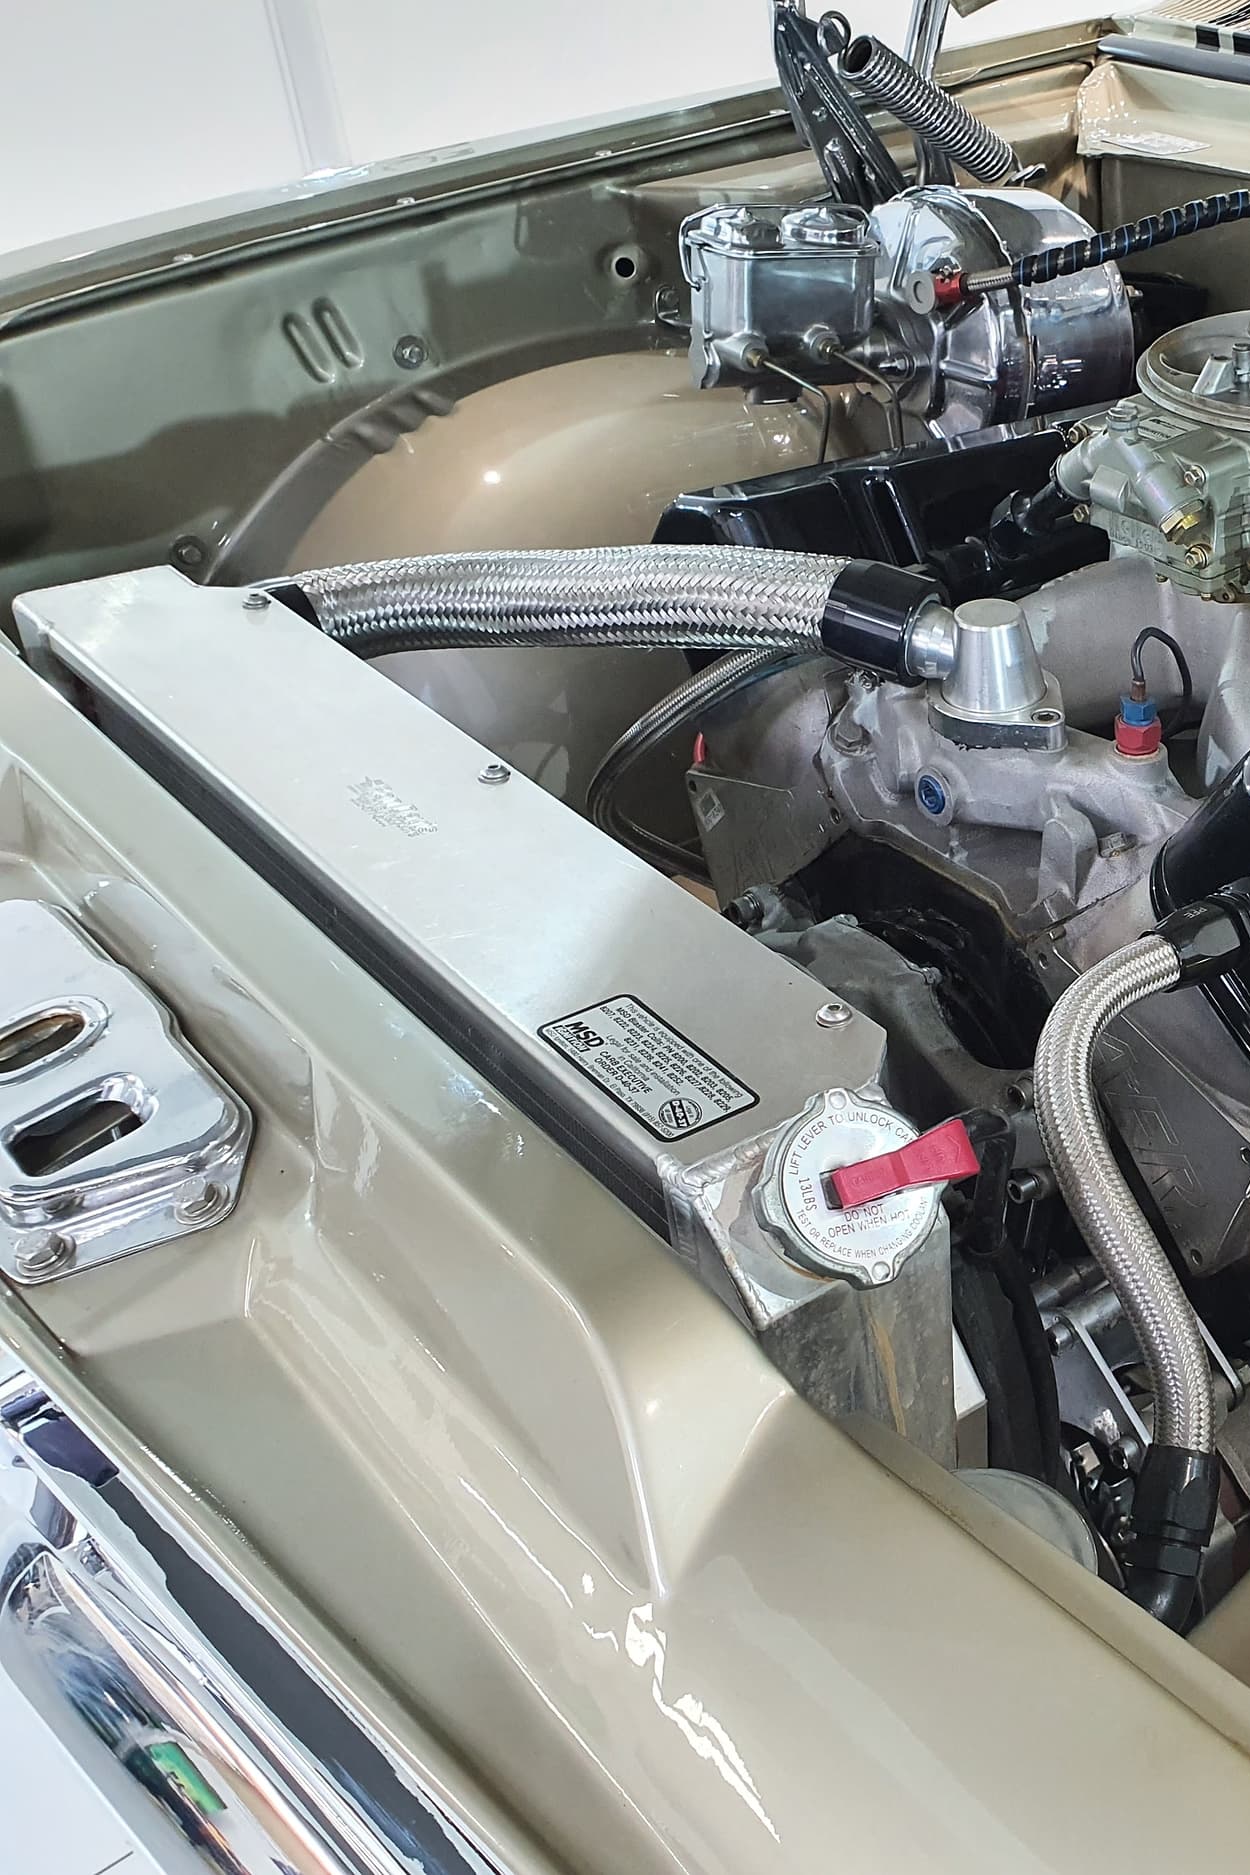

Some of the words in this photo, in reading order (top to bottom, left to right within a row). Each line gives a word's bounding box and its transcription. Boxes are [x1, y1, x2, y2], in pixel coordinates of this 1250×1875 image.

[565, 1021, 603, 1046] MSD
[594, 1057, 618, 1076] ORDER
[599, 1051, 619, 1065] CARB
[616, 1065, 652, 1093] EXECUTIVE
[789, 1150, 802, 1175] LIFT
[798, 1121, 827, 1151] LEVER
[828, 1114, 844, 1125] TO
[848, 1112, 892, 1131] UNLOCK
[799, 1178, 817, 1211] 13LBS
[828, 1224, 856, 1238] OPEN
[859, 1215, 888, 1231] WHEN
[890, 1208, 909, 1222] HOT
[844, 1210, 859, 1222] DO
[863, 1204, 884, 1218] NOT
[797, 1209, 811, 1227] TEST
[810, 1228, 820, 1240] OR
[820, 1236, 852, 1258] REPLACE
[855, 1249, 877, 1259] WHEN
[879, 1229, 913, 1257] CHANGING
